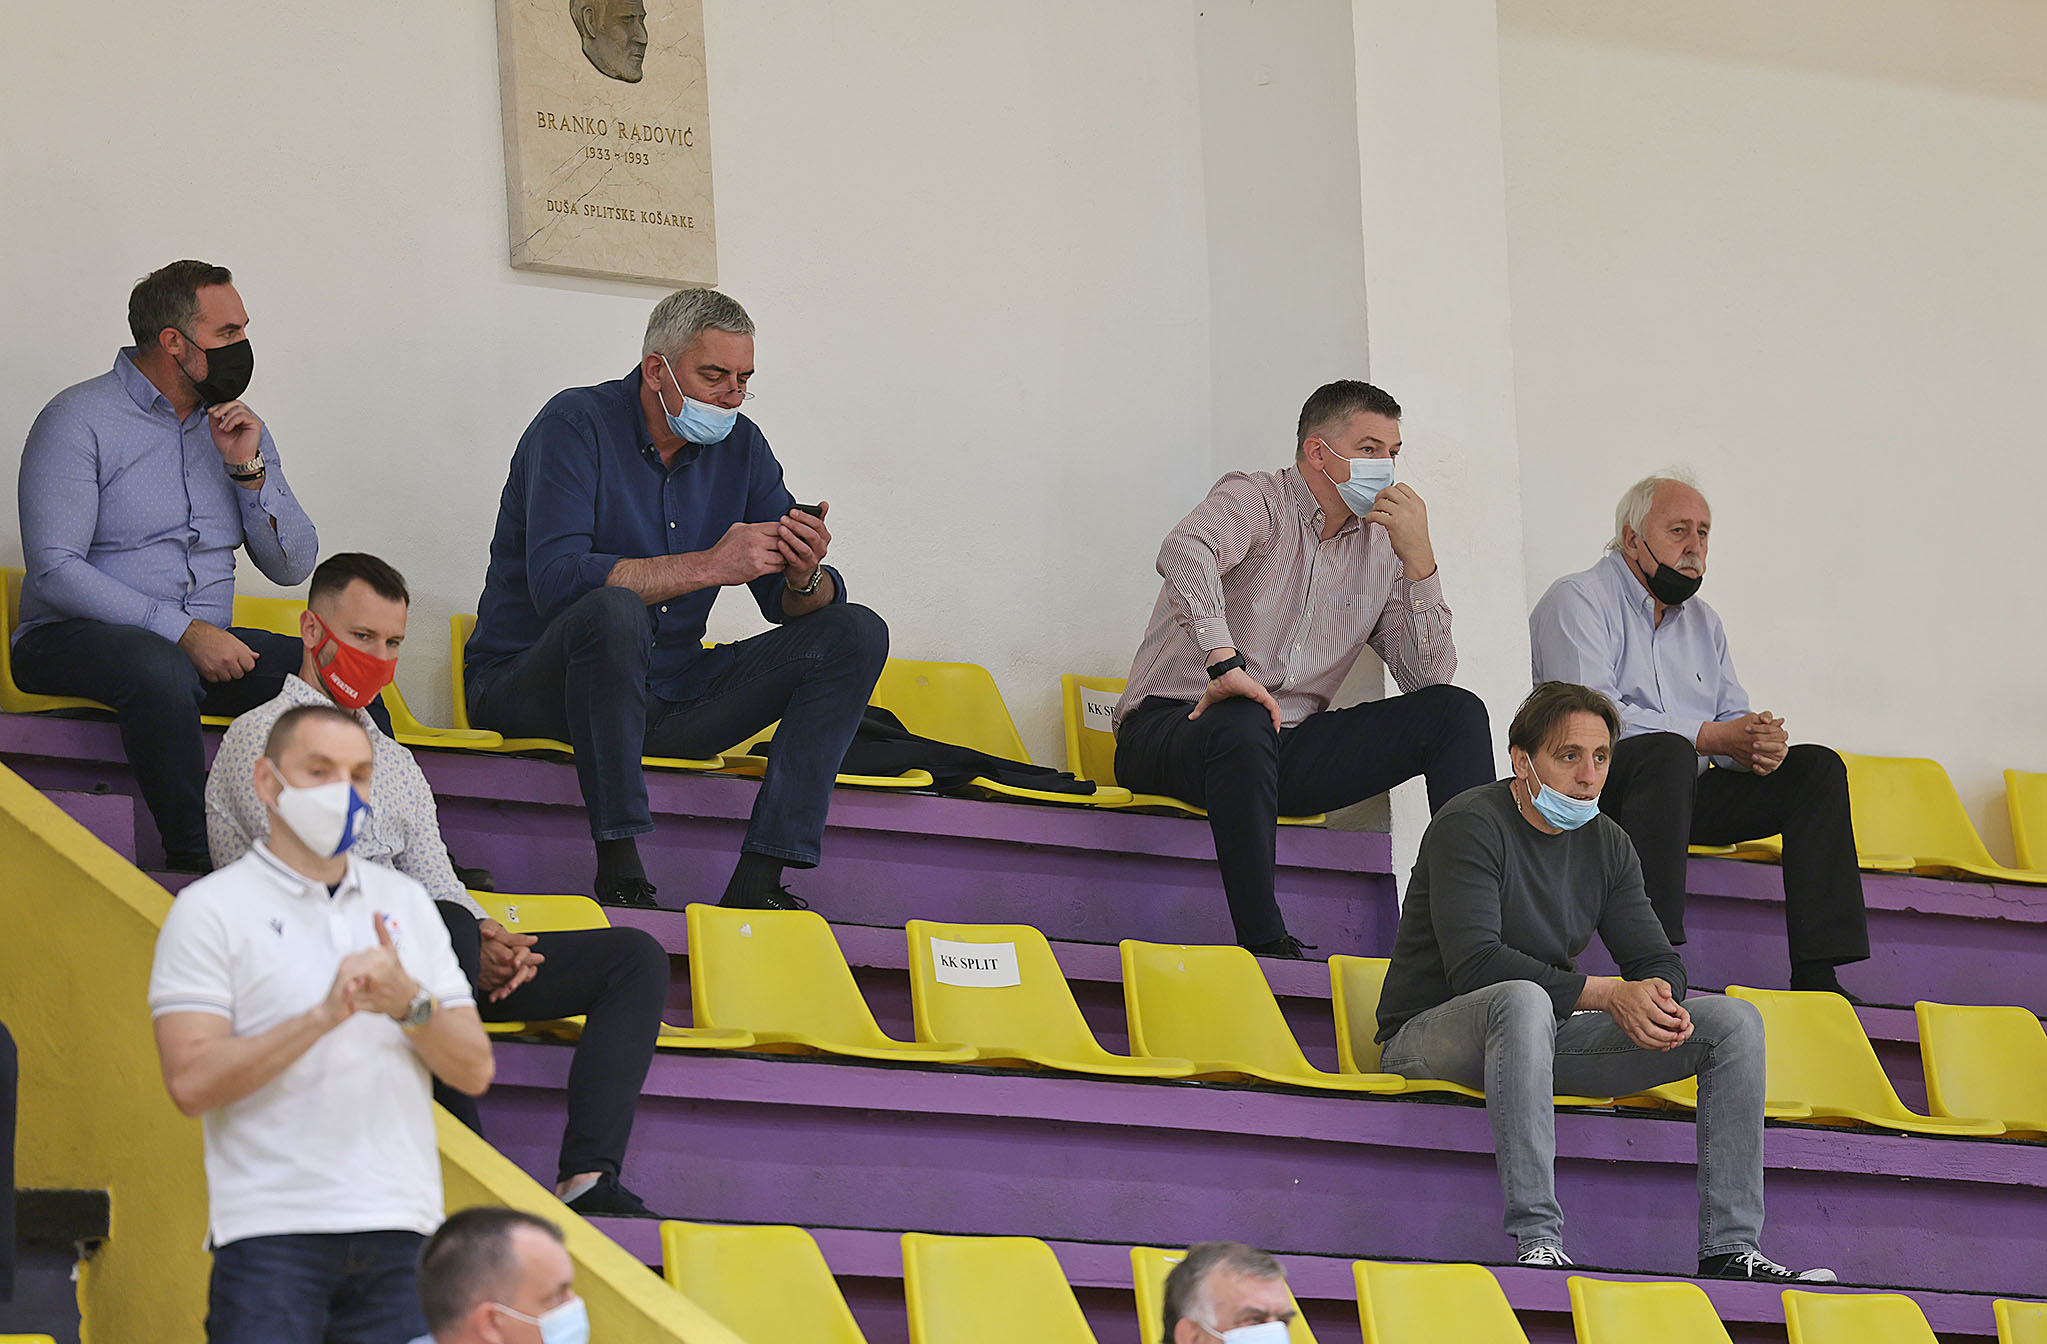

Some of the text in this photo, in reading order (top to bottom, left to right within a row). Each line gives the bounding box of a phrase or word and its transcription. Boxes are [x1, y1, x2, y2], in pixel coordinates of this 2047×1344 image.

[537, 111, 694, 148] BRANKO RADOVIĆ
[584, 146, 611, 161] 1933
[623, 152, 649, 166] 1993
[546, 199, 694, 229] DUŠA SPLITSKE KOŠARKE
[1087, 702, 1102, 716] KK
[940, 954, 998, 971] KK SPLIT
